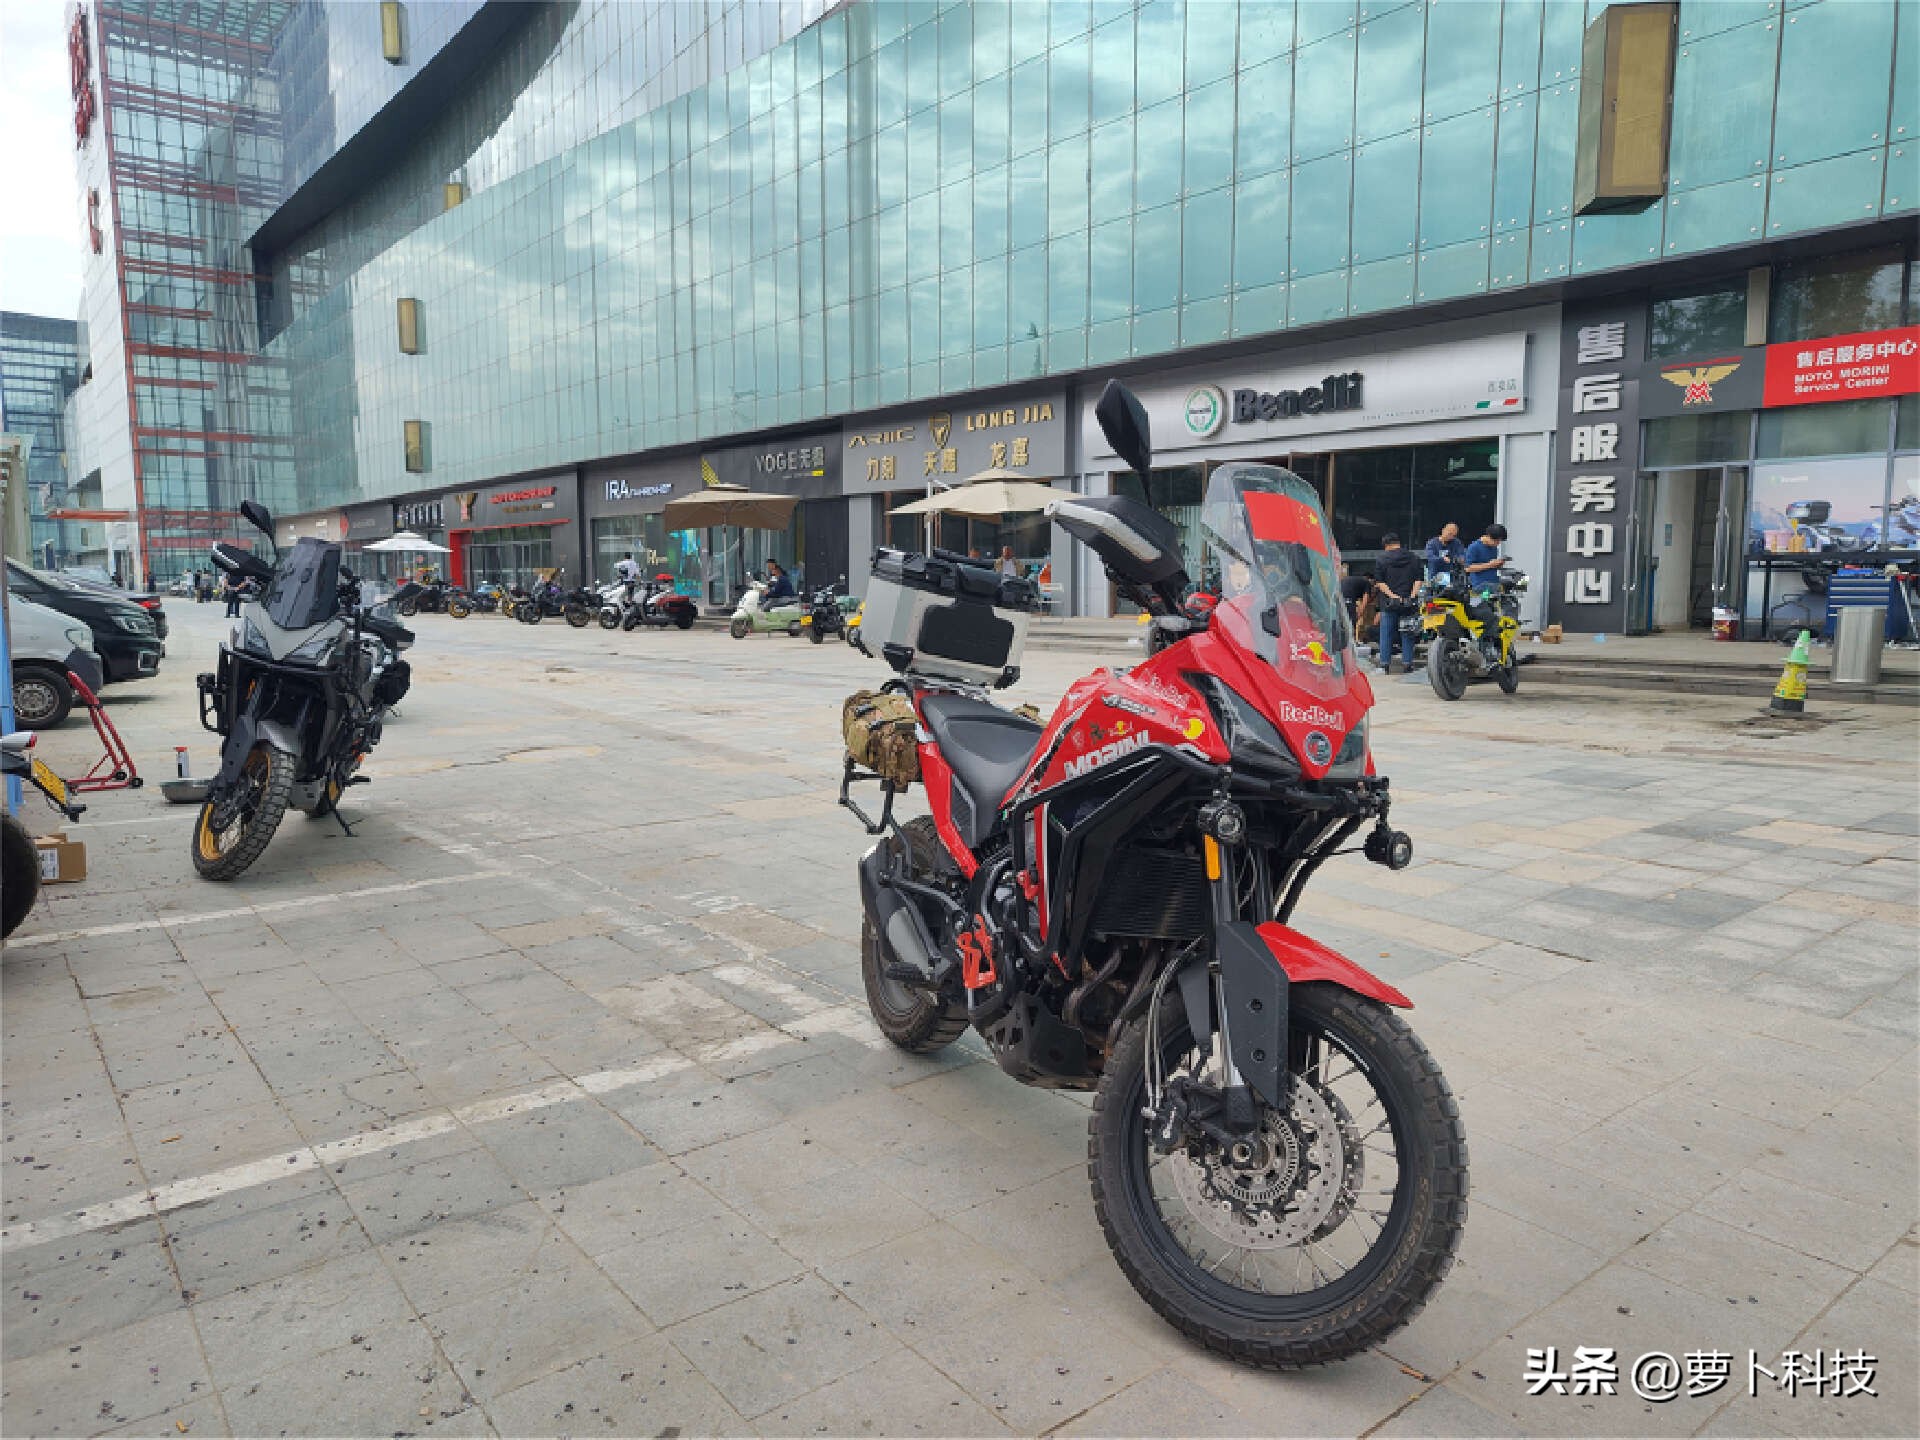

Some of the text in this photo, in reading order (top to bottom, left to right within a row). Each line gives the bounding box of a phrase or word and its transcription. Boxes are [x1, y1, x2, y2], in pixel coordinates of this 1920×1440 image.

[1796, 338, 1917, 368] 售后服务中心
[1794, 364, 1890, 385] MOTO MORINI
[1794, 377, 1890, 393] Service Center
[1232, 371, 1364, 424] Benelli
[966, 403, 1054, 433] LONG JIA
[1564, 321, 1625, 605] 售后服务中心
